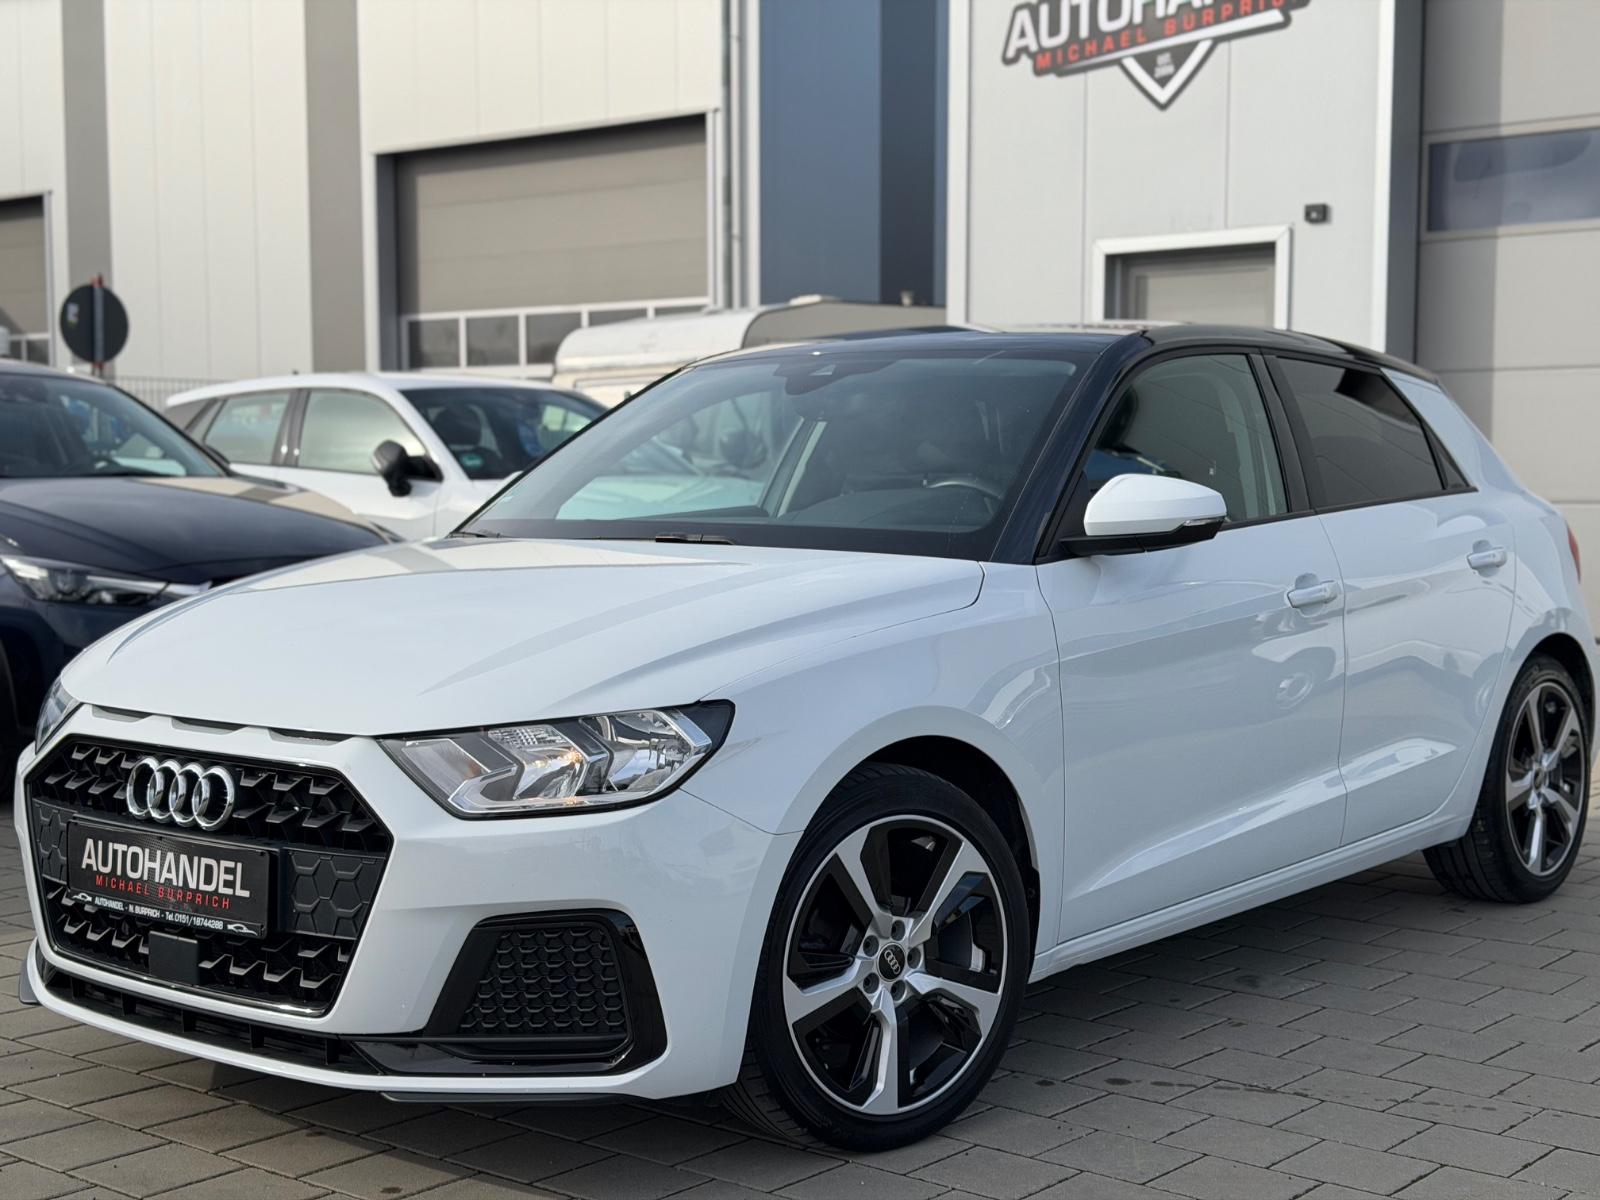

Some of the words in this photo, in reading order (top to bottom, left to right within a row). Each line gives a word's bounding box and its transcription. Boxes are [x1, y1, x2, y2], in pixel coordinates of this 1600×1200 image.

[1004, 0, 1210, 60] AUTO
[1036, 26, 1148, 70] MICHAEL
[1163, 0, 1295, 36] BURPRI
[81, 838, 250, 898] AUTOHANDEL
[95, 874, 150, 896] MICHAEL
[158, 883, 231, 910] BURPRICH
[95, 896, 124, 911] AUTOHANDEL
